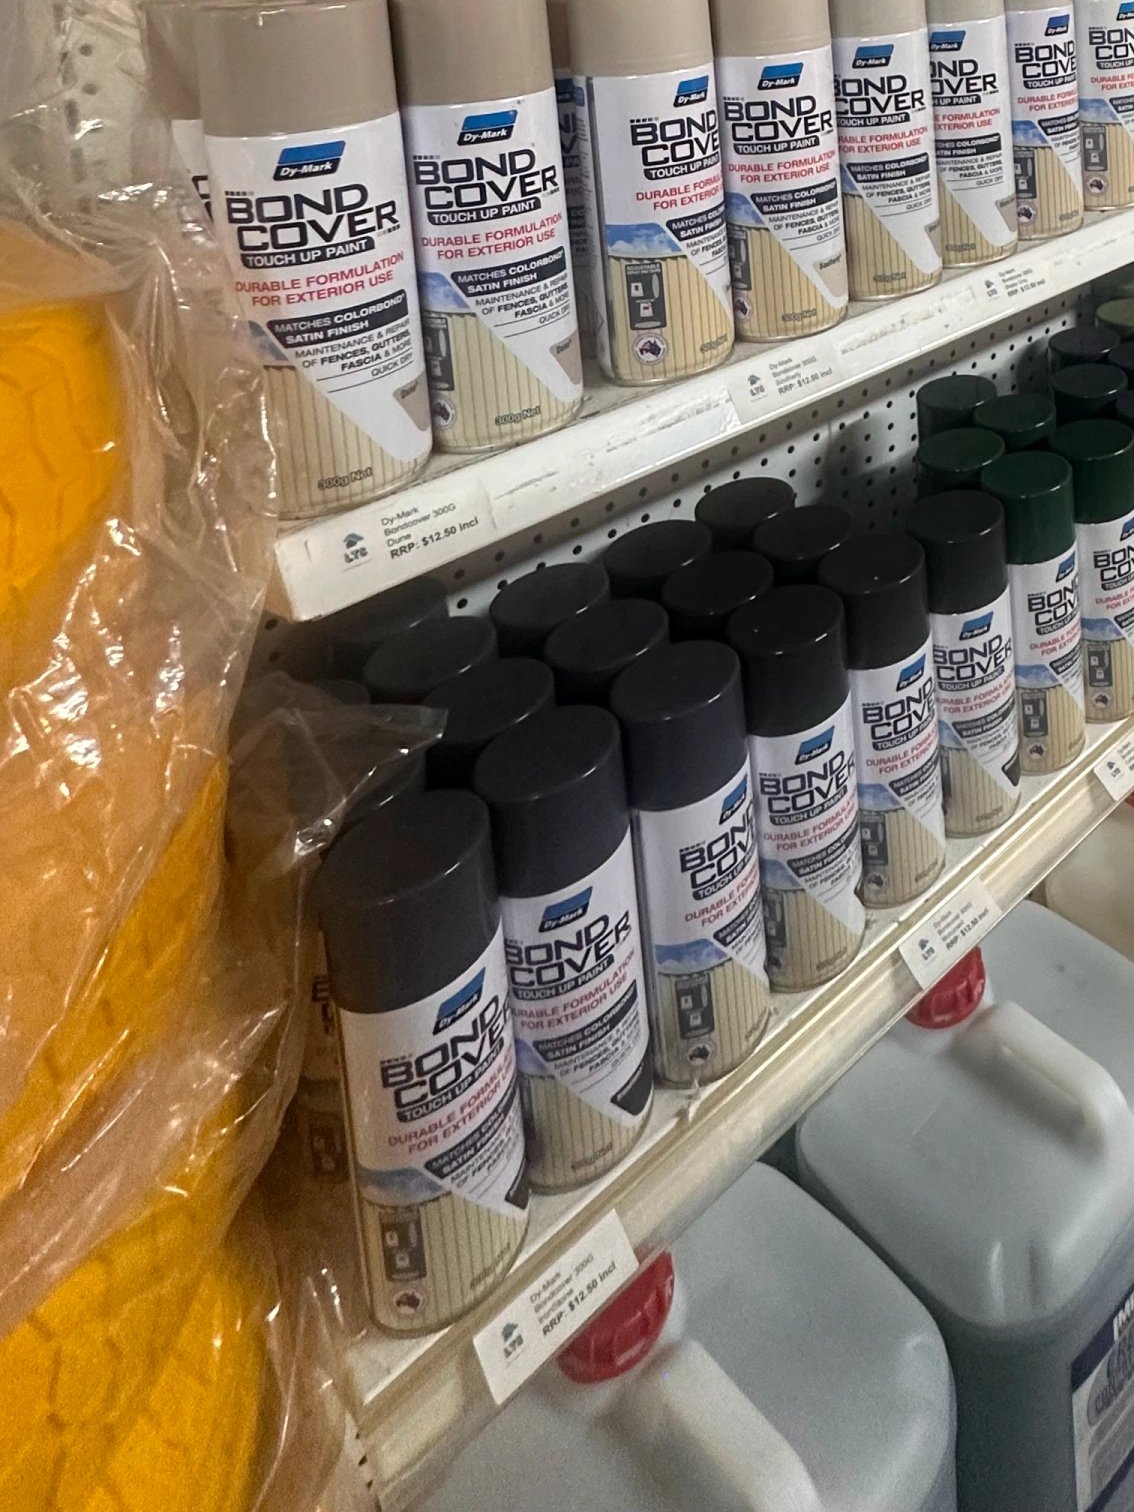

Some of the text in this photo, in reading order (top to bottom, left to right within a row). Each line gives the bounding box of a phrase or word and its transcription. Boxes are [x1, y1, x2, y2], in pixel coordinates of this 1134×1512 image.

[762, 77, 795, 87] Dy-Mark
[724, 95, 816, 121] BOND
[881, 114, 907, 124] PAINT
[463, 129, 507, 142] Dy-Mark
[731, 110, 833, 141] COVER
[738, 138, 816, 154] TOUCH PAINT
[857, 141, 904, 153] EXTERIOR
[280, 161, 333, 177] Dy-Mark
[414, 149, 536, 185] BOND
[728, 163, 775, 172] DURABLE
[740, 167, 813, 183] FOR EXTERIOR
[425, 165, 558, 210] COVER
[226, 184, 368, 224] BOND
[433, 200, 536, 224] TOUCH UP PAINT
[237, 200, 399, 252] COVER
[422, 213, 562, 247] DURABLE FORMULATION
[247, 240, 368, 267] TOUCH UP PAINT
[438, 228, 556, 259] FOR EXTERIOR USE
[236, 251, 404, 293] DURABLE FORMULATION
[458, 269, 507, 283] MATCHES
[467, 272, 538, 293] SATIN FINISH
[252, 270, 393, 306] FOR EXTERIOR USE
[275, 318, 331, 333] MATCHES
[285, 320, 369, 344] SATIN FINISH
[295, 334, 374, 359] MAINTENANCE
[381, 506, 419, 527] Dy-Mark
[432, 503, 457, 517] 300G
[387, 532, 411, 547] Dune
[390, 517, 478, 559] RRP: $12.50 incl
[933, 634, 1002, 665] BOND
[760, 751, 845, 795] BOND
[775, 812, 808, 825] TOUCH
[764, 829, 809, 841] DURABLE
[777, 843, 798, 851] FOR
[506, 914, 609, 965] BOND
[510, 910, 631, 987] COVER
[517, 959, 610, 999] TOUCH PAINT
[381, 994, 499, 1088] BOND
[404, 1092, 451, 1121] TOUCH
[388, 1109, 456, 1147] DURABLE
[408, 1137, 438, 1155] FOR
[568, 1279, 598, 1311] $12.50
